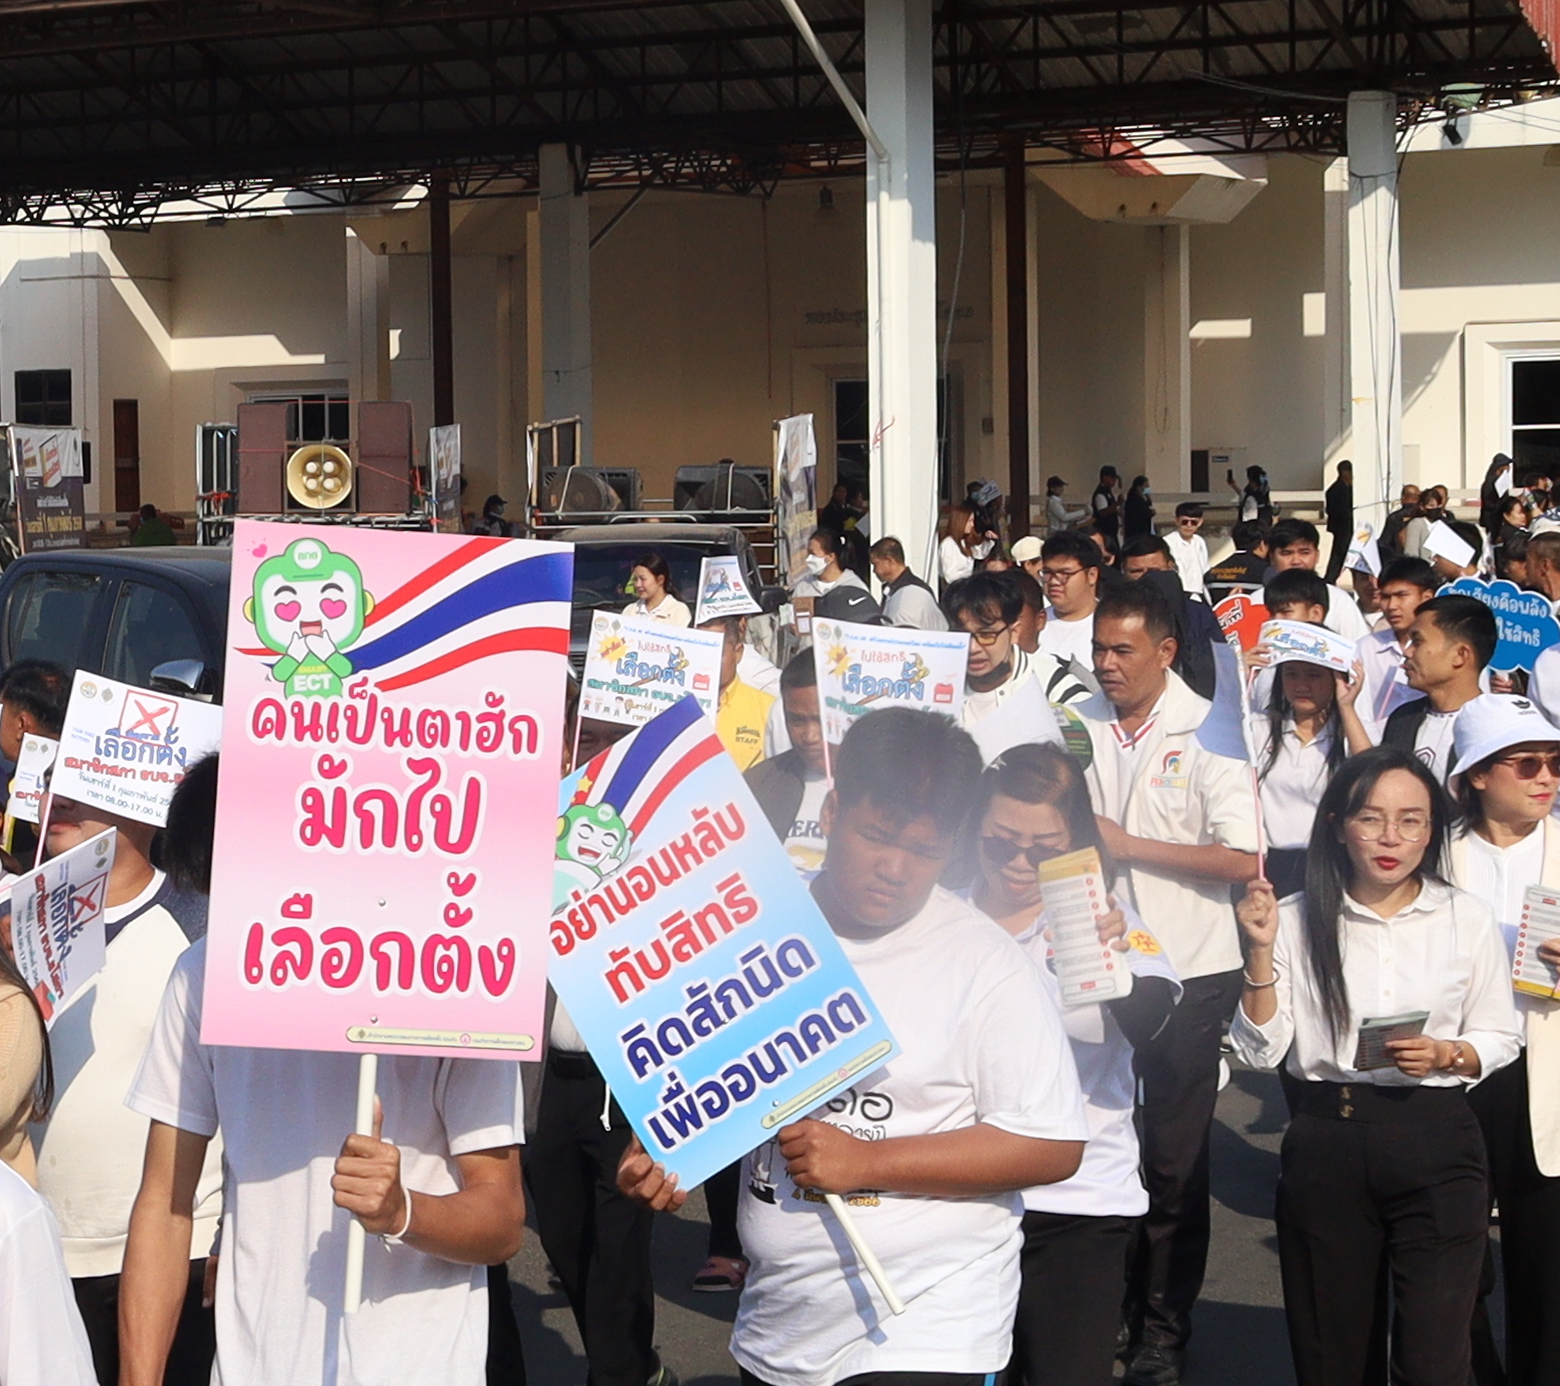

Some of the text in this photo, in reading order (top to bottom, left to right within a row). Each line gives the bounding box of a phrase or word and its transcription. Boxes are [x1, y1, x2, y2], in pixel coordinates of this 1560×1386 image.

[293, 672, 333, 692] ECT
[298, 664, 328, 673] SMART
[616, 647, 686, 687] เลือกตั้ง
[842, 661, 925, 701] เลือกตั้ง
[94, 725, 187, 768] เลือกตั้ง
[251, 676, 539, 755] คนเป็นตาฮัก
[735, 737, 760, 746] STAFF
[64, 756, 136, 780] สมาชิกสภา
[300, 757, 481, 856] มักไป
[550, 801, 748, 957] อย่านอนหลับ
[50, 881, 84, 964] เลือกตั้ง
[243, 872, 518, 1000] เลือกตั้ง
[605, 875, 759, 1007] ทับสิทธิ
[625, 931, 817, 1083] คิดสักนิด
[647, 989, 868, 1153] เพื่ออนาคต
